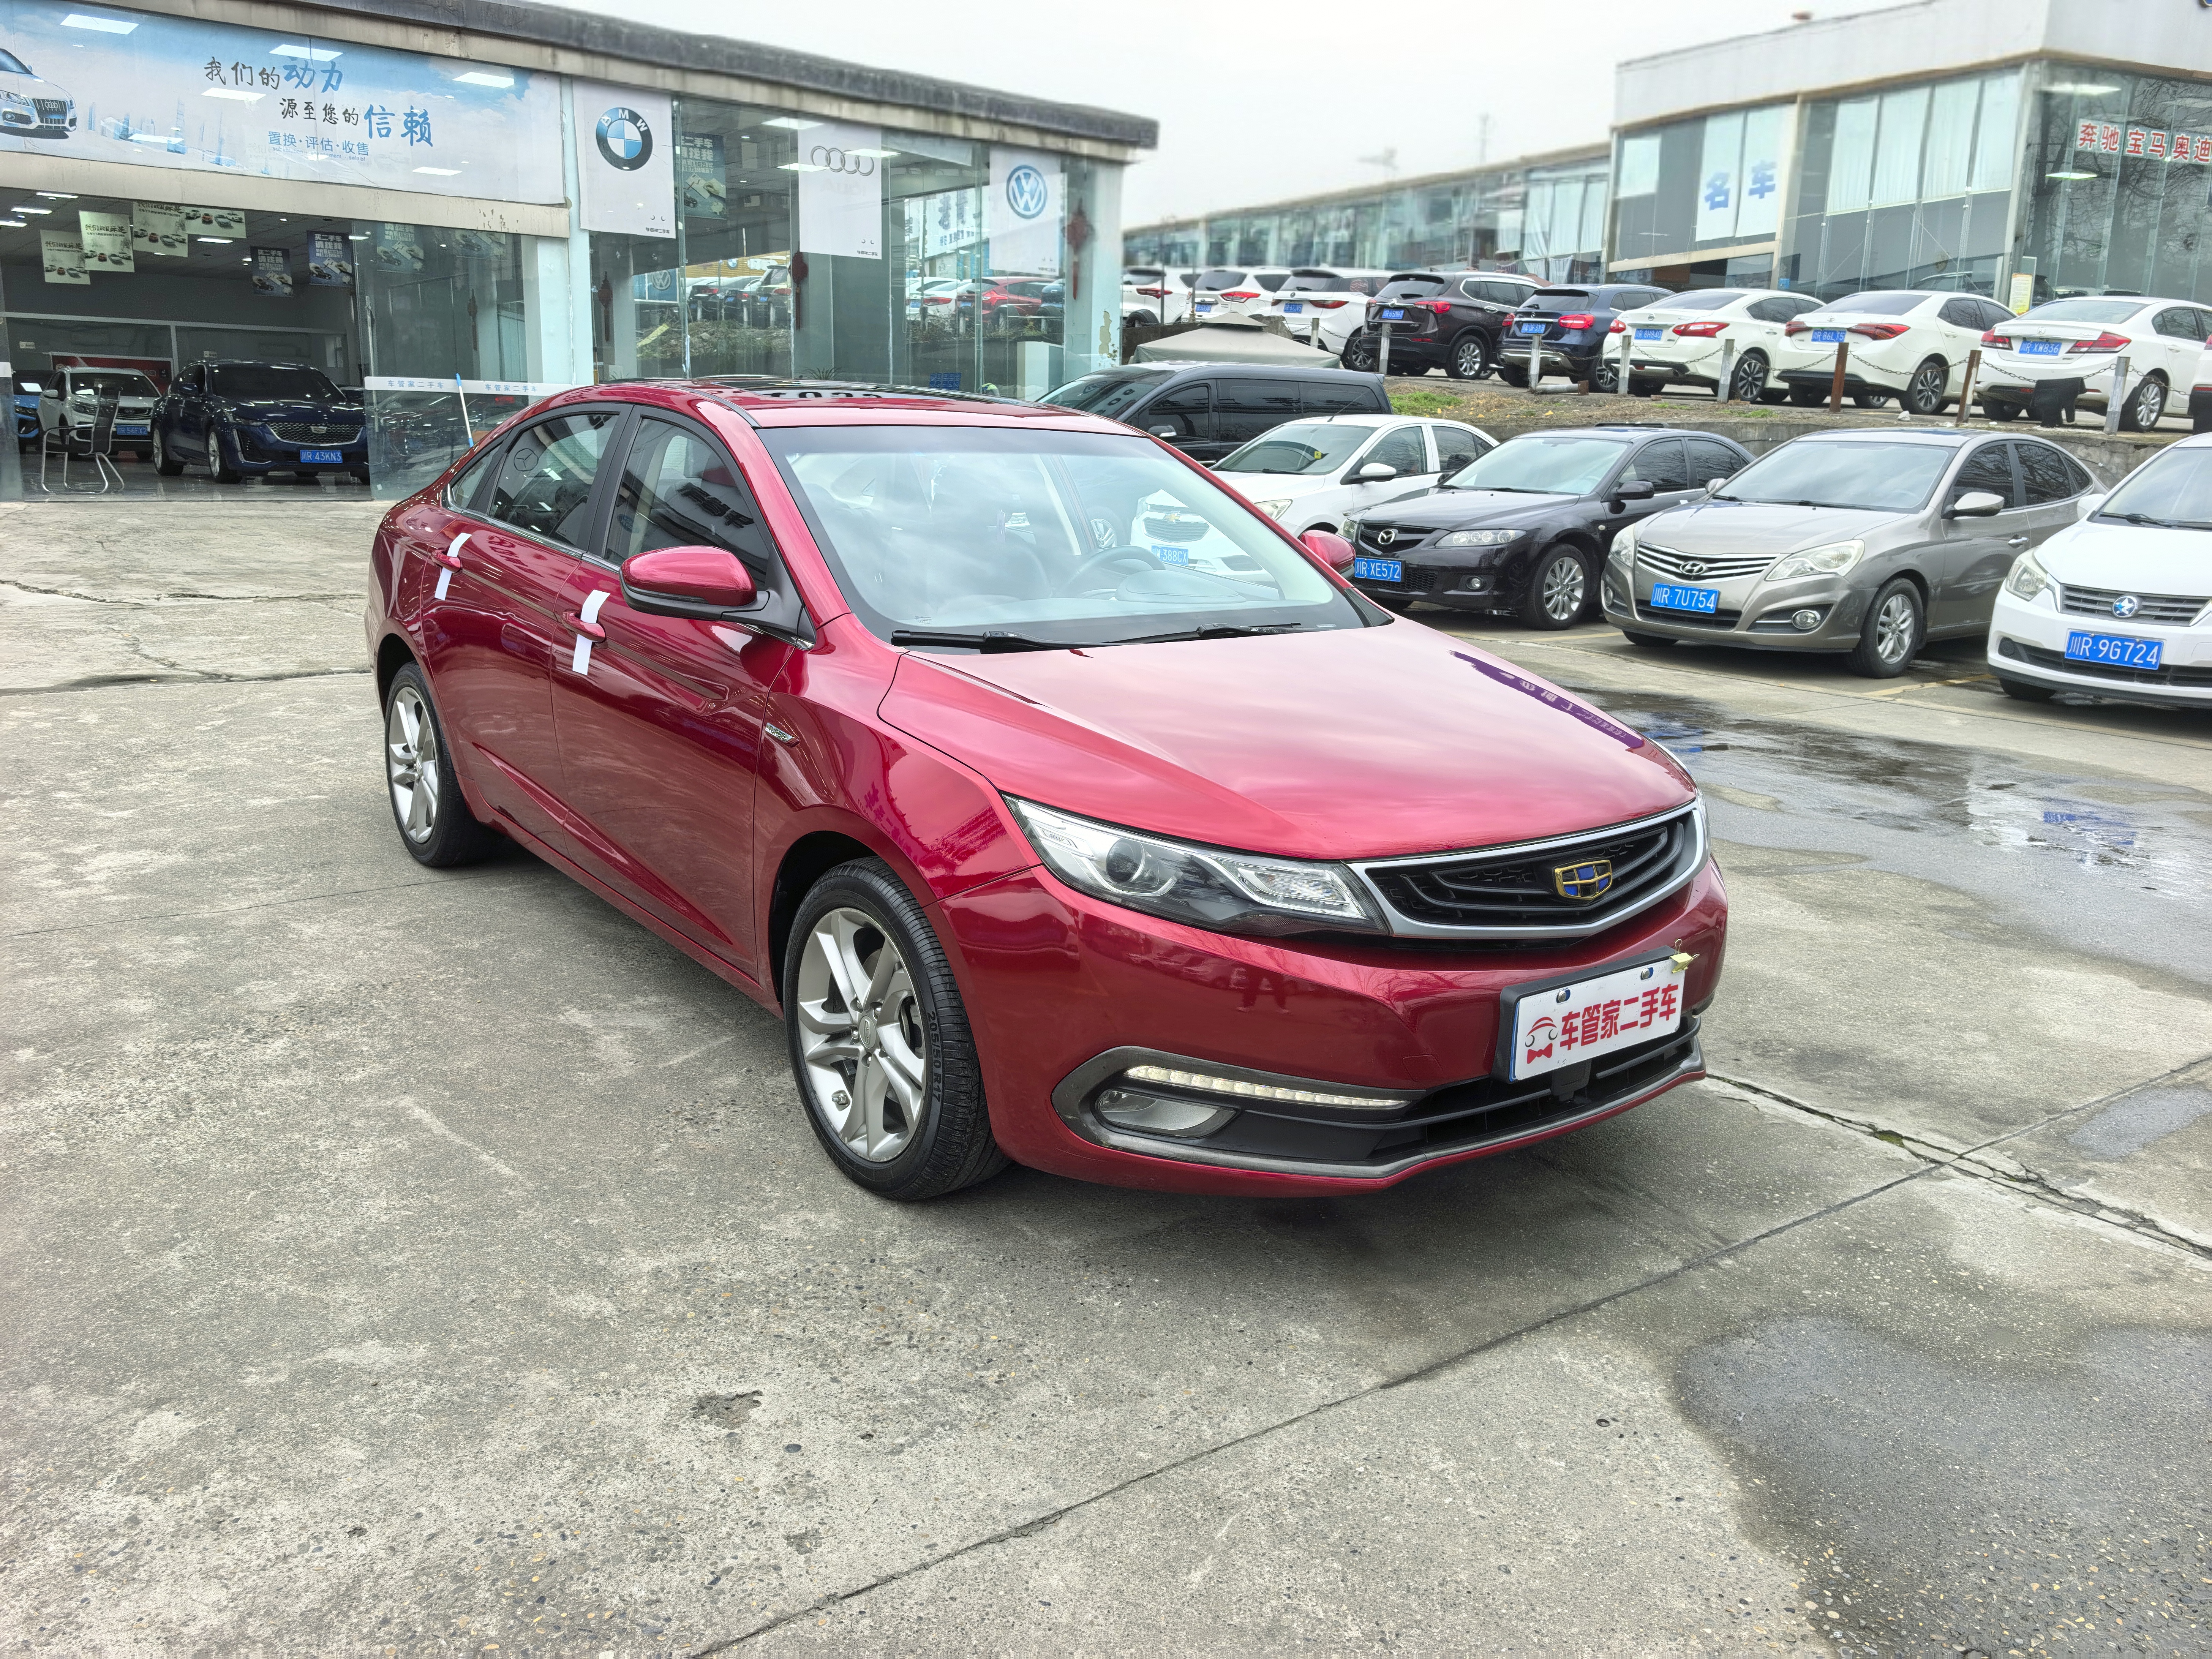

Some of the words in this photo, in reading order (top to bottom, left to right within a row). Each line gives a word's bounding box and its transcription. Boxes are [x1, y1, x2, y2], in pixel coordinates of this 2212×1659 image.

[204, 56, 343, 93] 我们的动力
[279, 98, 433, 147] 源至您的信赖
[601, 108, 648, 132] BMW
[2079, 123, 2212, 162] 奔驰宝马奥迪
[485, 383, 537, 392] 车管家二手车
[1653, 587, 1715, 609] 川R·7U754
[2068, 636, 2159, 665] 川R·9G724
[1560, 984, 1678, 1051] 车管家二手车
